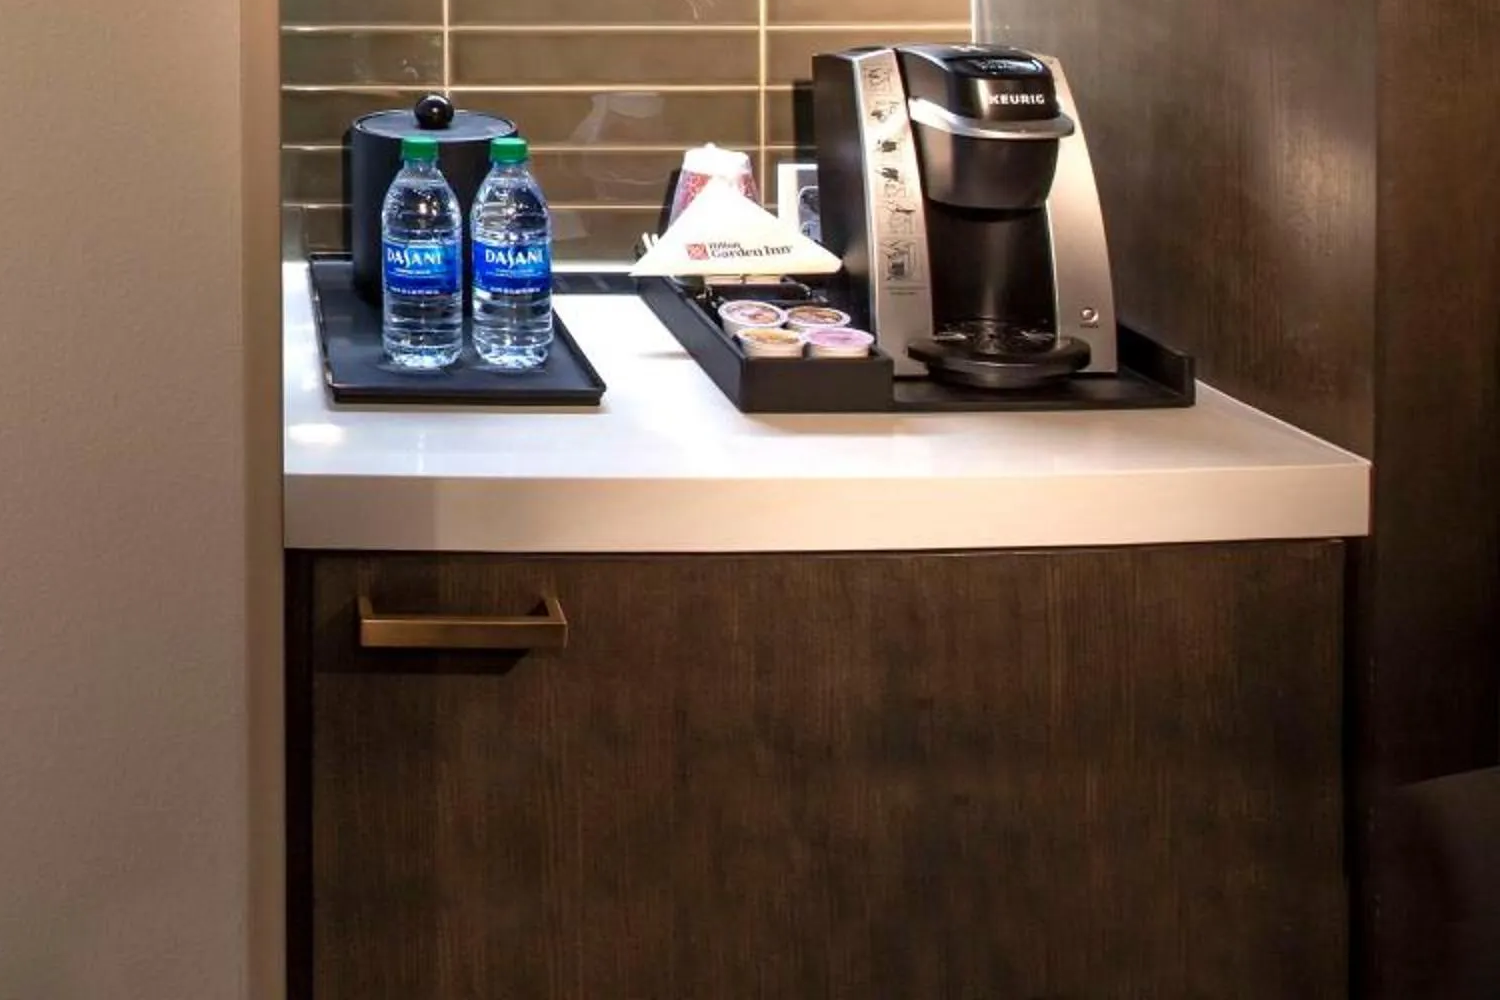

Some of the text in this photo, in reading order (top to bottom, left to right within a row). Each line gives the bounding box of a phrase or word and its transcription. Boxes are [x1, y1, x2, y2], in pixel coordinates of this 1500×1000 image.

[989, 93, 1045, 105] KEURIG
[387, 247, 442, 268] DASANI
[485, 248, 543, 268] DASANI
[711, 244, 791, 258] Garden Inn
